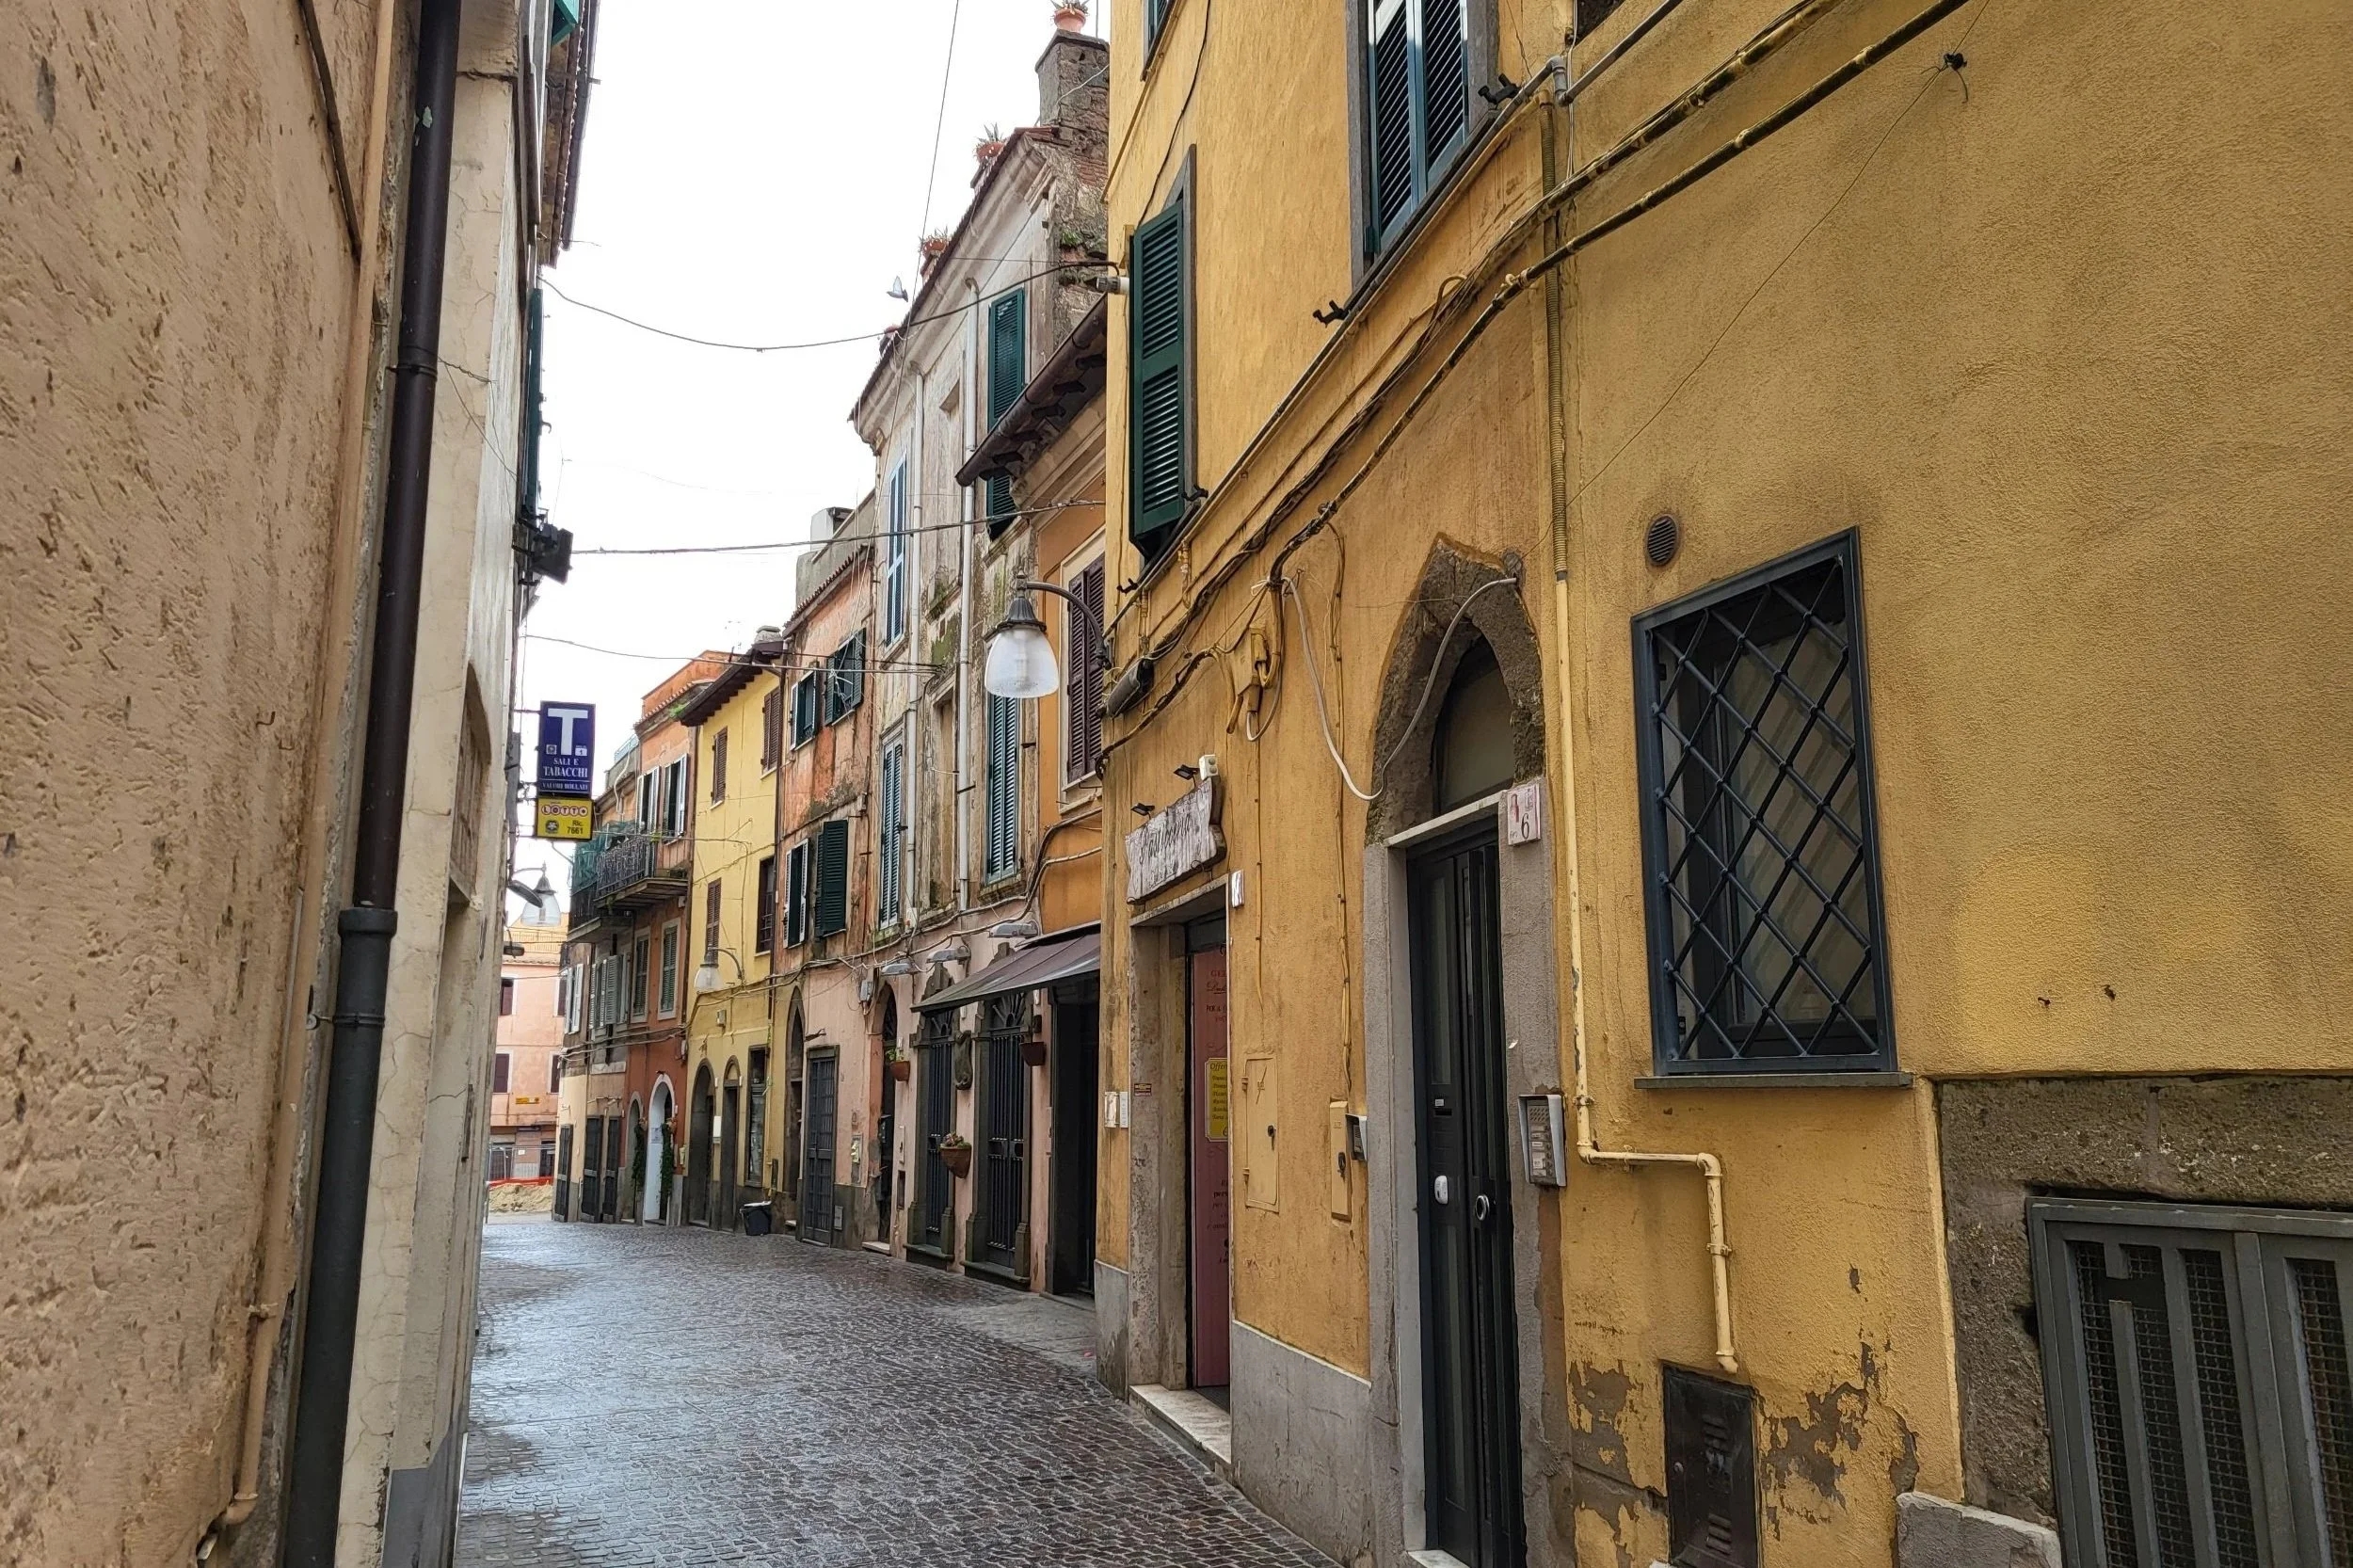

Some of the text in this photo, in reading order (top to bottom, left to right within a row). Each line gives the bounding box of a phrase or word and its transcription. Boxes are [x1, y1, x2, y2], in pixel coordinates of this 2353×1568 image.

[548, 708, 588, 756] T
[553, 757, 580, 766] SALI E
[542, 766, 588, 778] TABACCHI
[541, 805, 588, 817] LOTTO
[567, 826, 584, 835] 7661
[1521, 812, 1530, 840] 6
